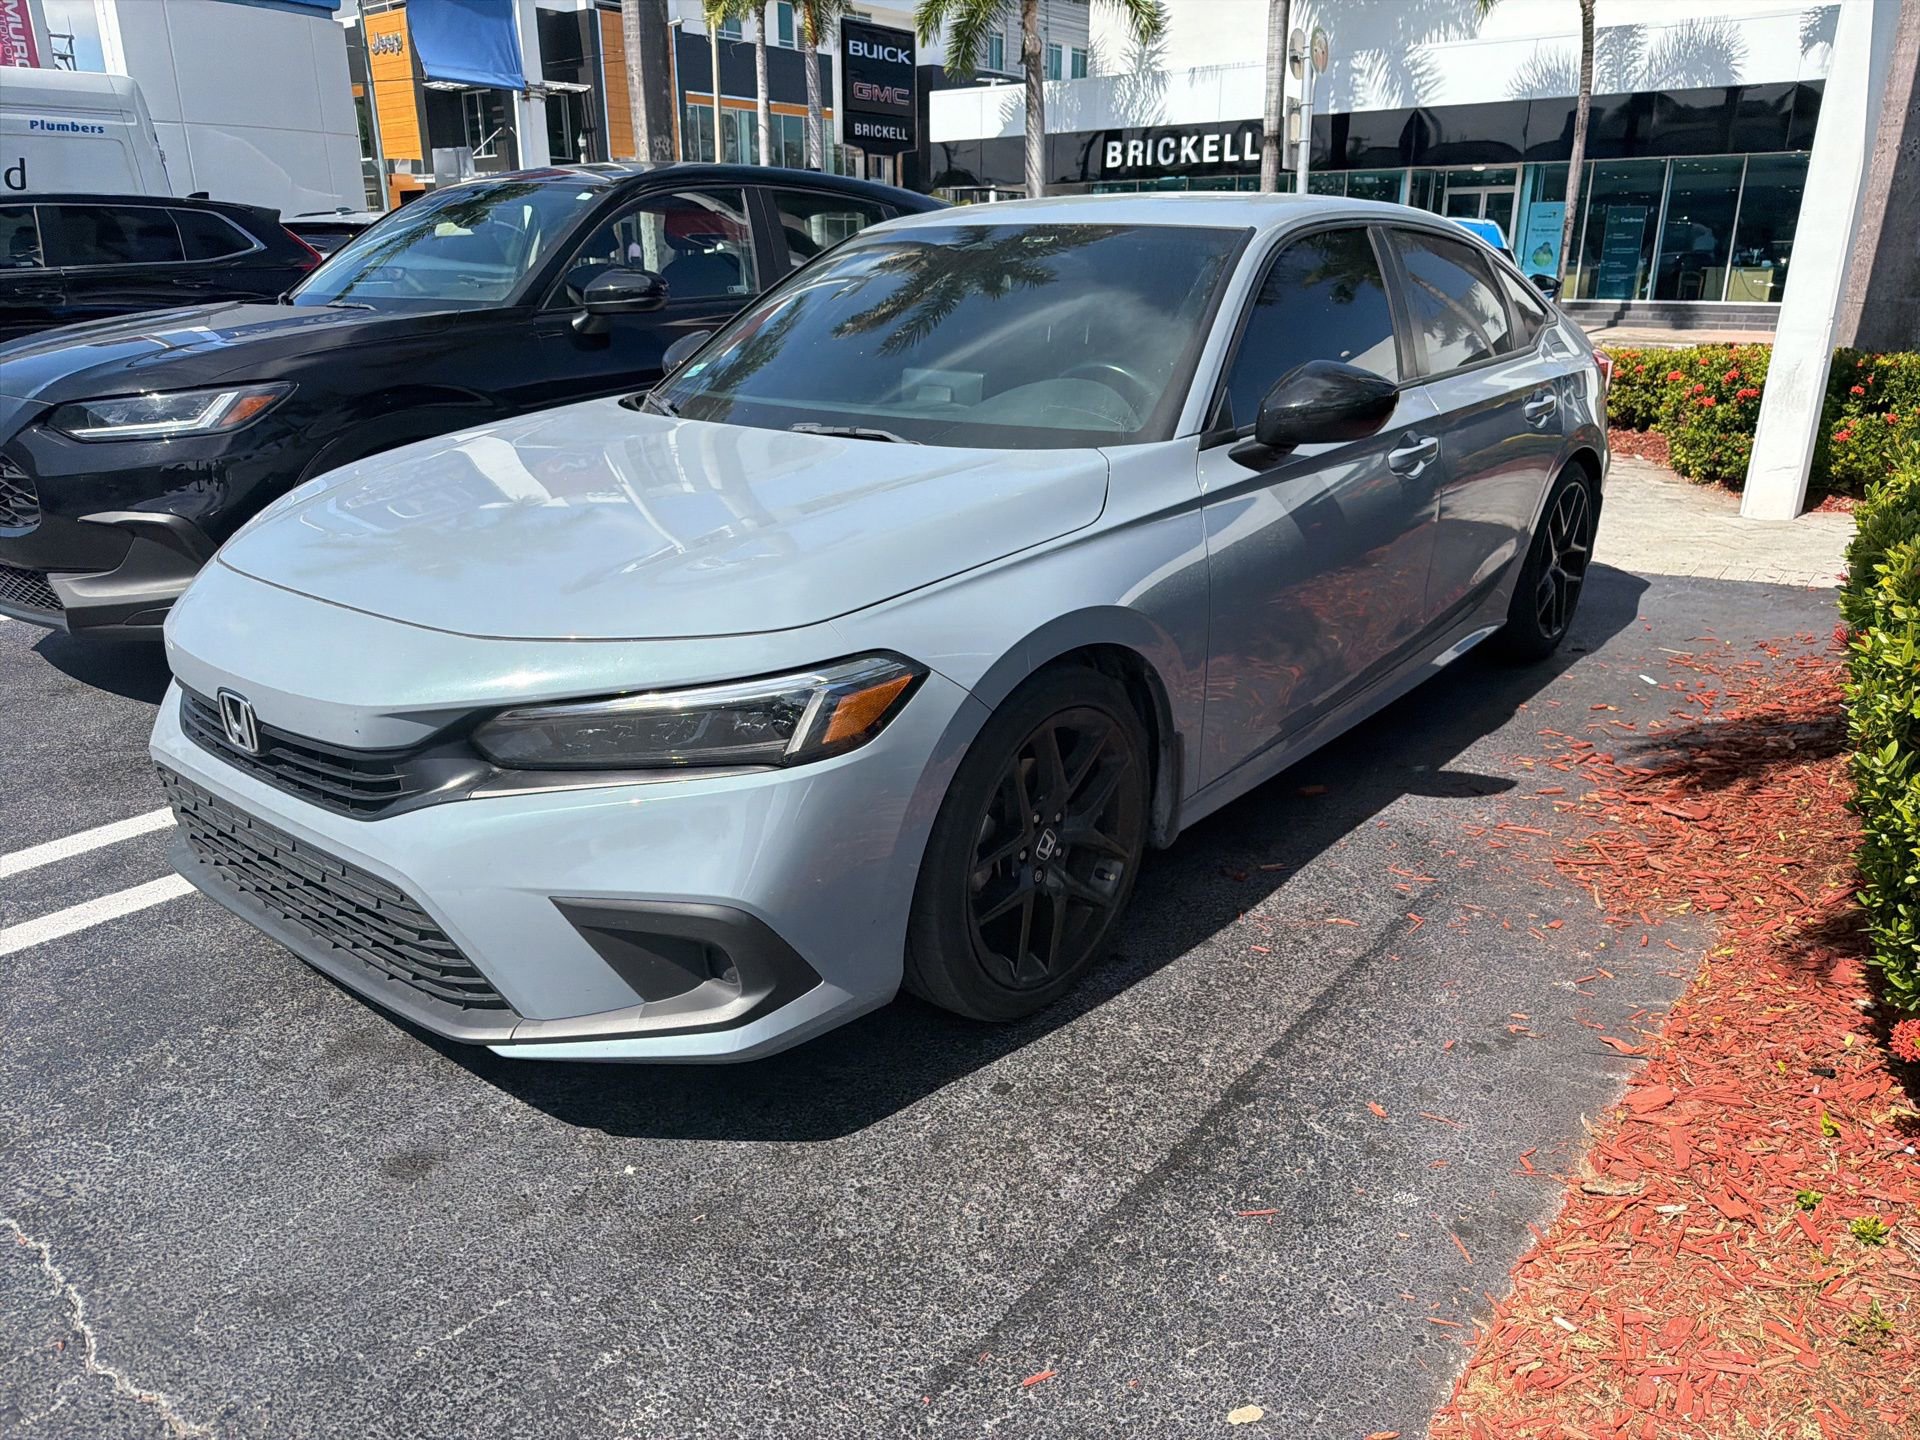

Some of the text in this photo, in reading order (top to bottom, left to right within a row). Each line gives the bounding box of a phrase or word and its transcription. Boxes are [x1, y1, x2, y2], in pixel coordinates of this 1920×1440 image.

[371, 31, 403, 56] Jeep
[848, 39, 912, 65] BUICK
[853, 81, 910, 106] GMC
[29, 119, 105, 134] Plumbers
[854, 122, 909, 141] BRICKELL
[1105, 131, 1261, 169] BRICKELL
